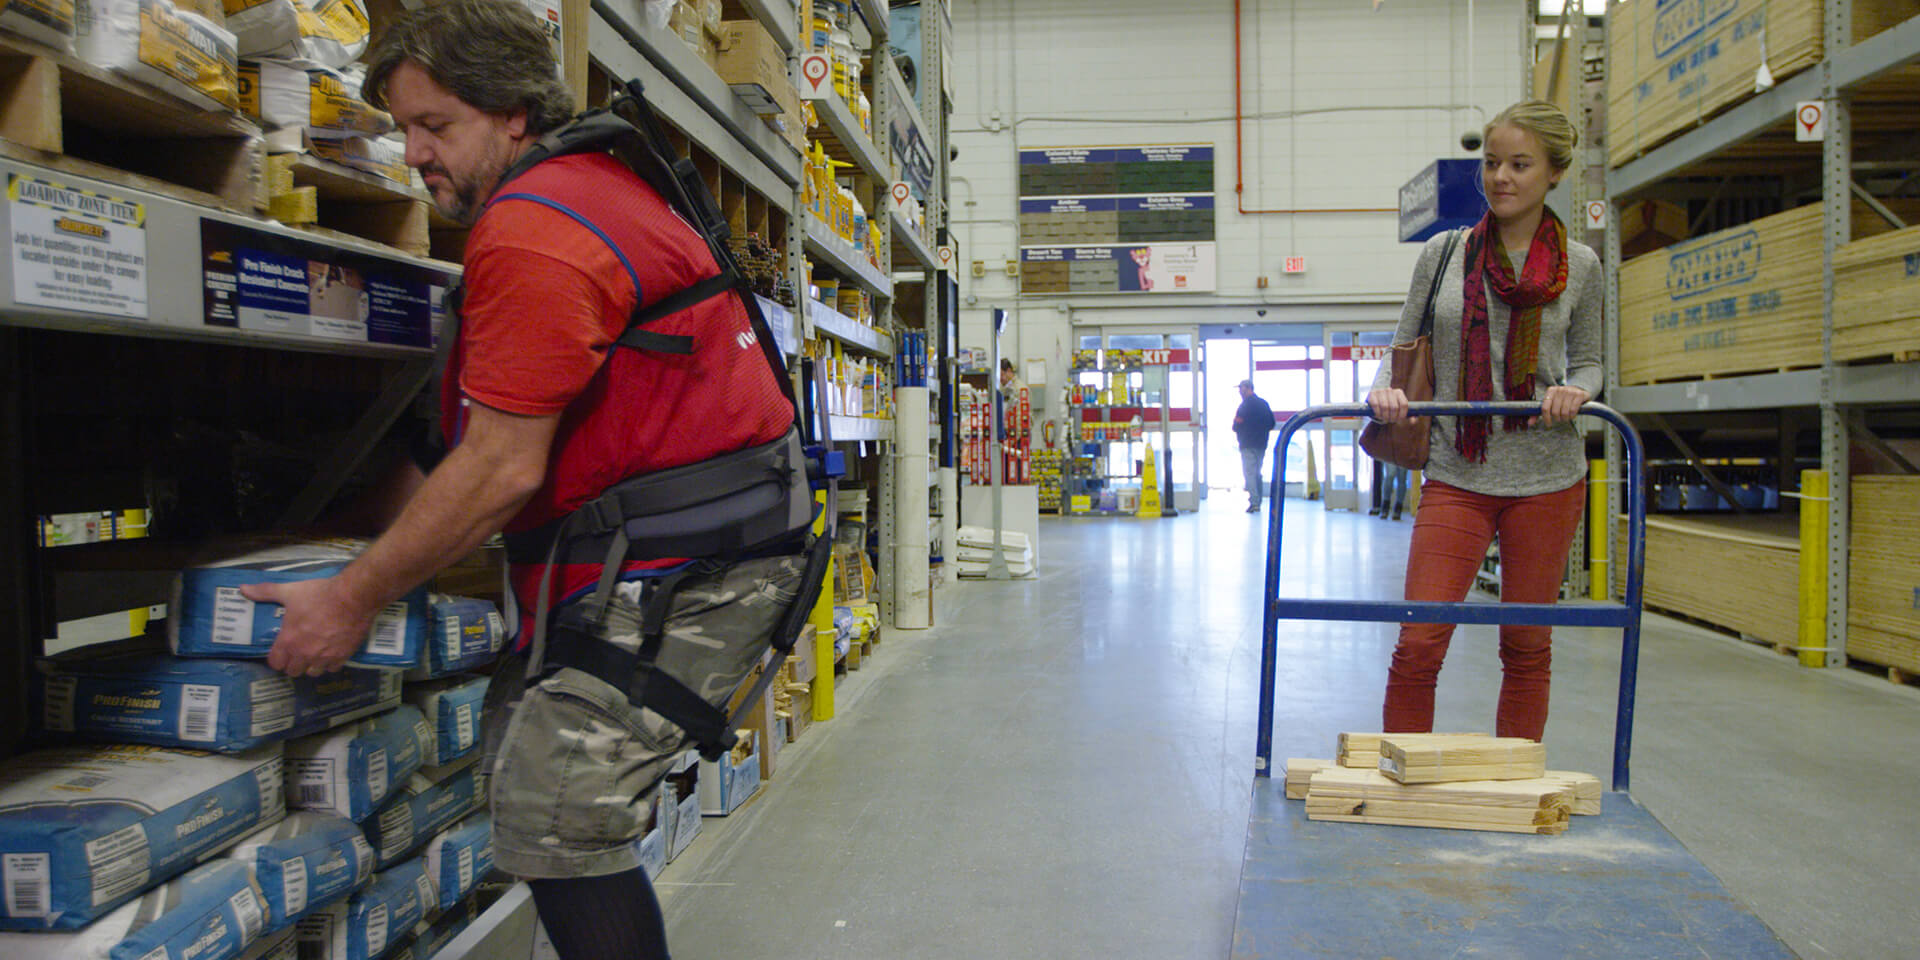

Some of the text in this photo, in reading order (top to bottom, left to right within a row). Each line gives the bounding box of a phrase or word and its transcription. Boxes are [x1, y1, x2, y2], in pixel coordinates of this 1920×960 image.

[19, 181, 137, 221] LOADING ZONE ITEM
[1286, 257, 1304, 271] EXIT
[1143, 350, 1171, 364] XIT
